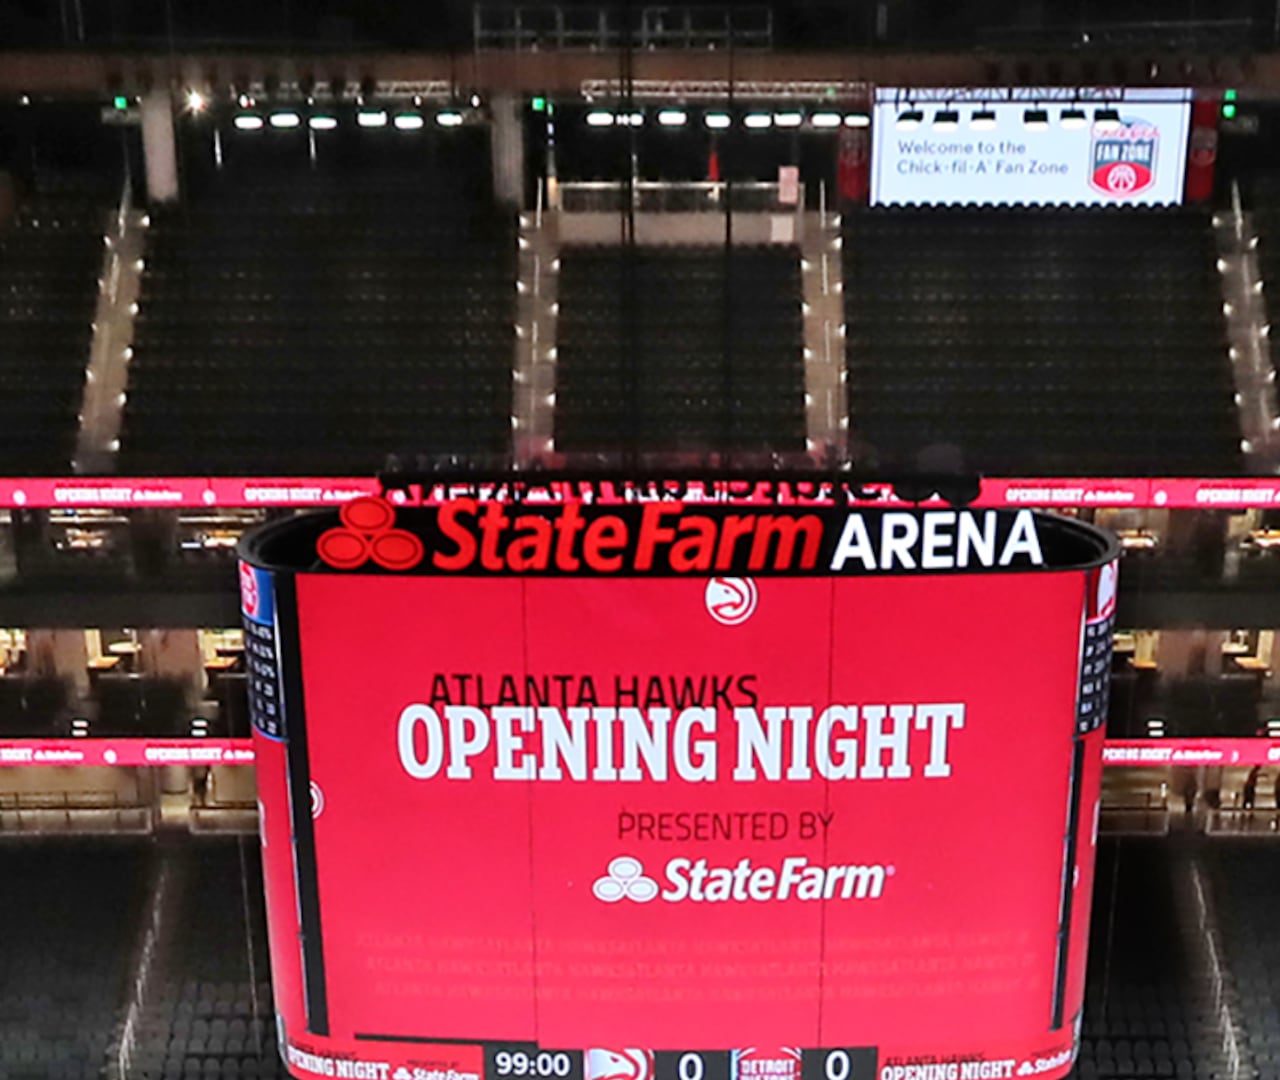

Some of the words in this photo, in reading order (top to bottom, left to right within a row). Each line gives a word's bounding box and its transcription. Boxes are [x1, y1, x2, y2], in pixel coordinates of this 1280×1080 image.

[898, 140, 973, 155] Welcome
[978, 140, 994, 155] to
[999, 140, 1026, 155] the
[995, 160, 1023, 174] Fan
[1028, 160, 1069, 174] Zone
[831, 509, 1044, 572] ARENA
[429, 675, 602, 709] ATLANTA
[615, 674, 758, 708] HAWKS
[397, 703, 718, 782] OPENING
[734, 702, 965, 782] NIGHT
[617, 813, 789, 842] PRESENTED
[799, 812, 834, 841] BY
[335, 1058, 390, 1080] NIGHT
[494, 1051, 571, 1077] 99:00
[740, 1058, 796, 1075] DETROIT
[961, 1059, 1016, 1080] NIGHT
